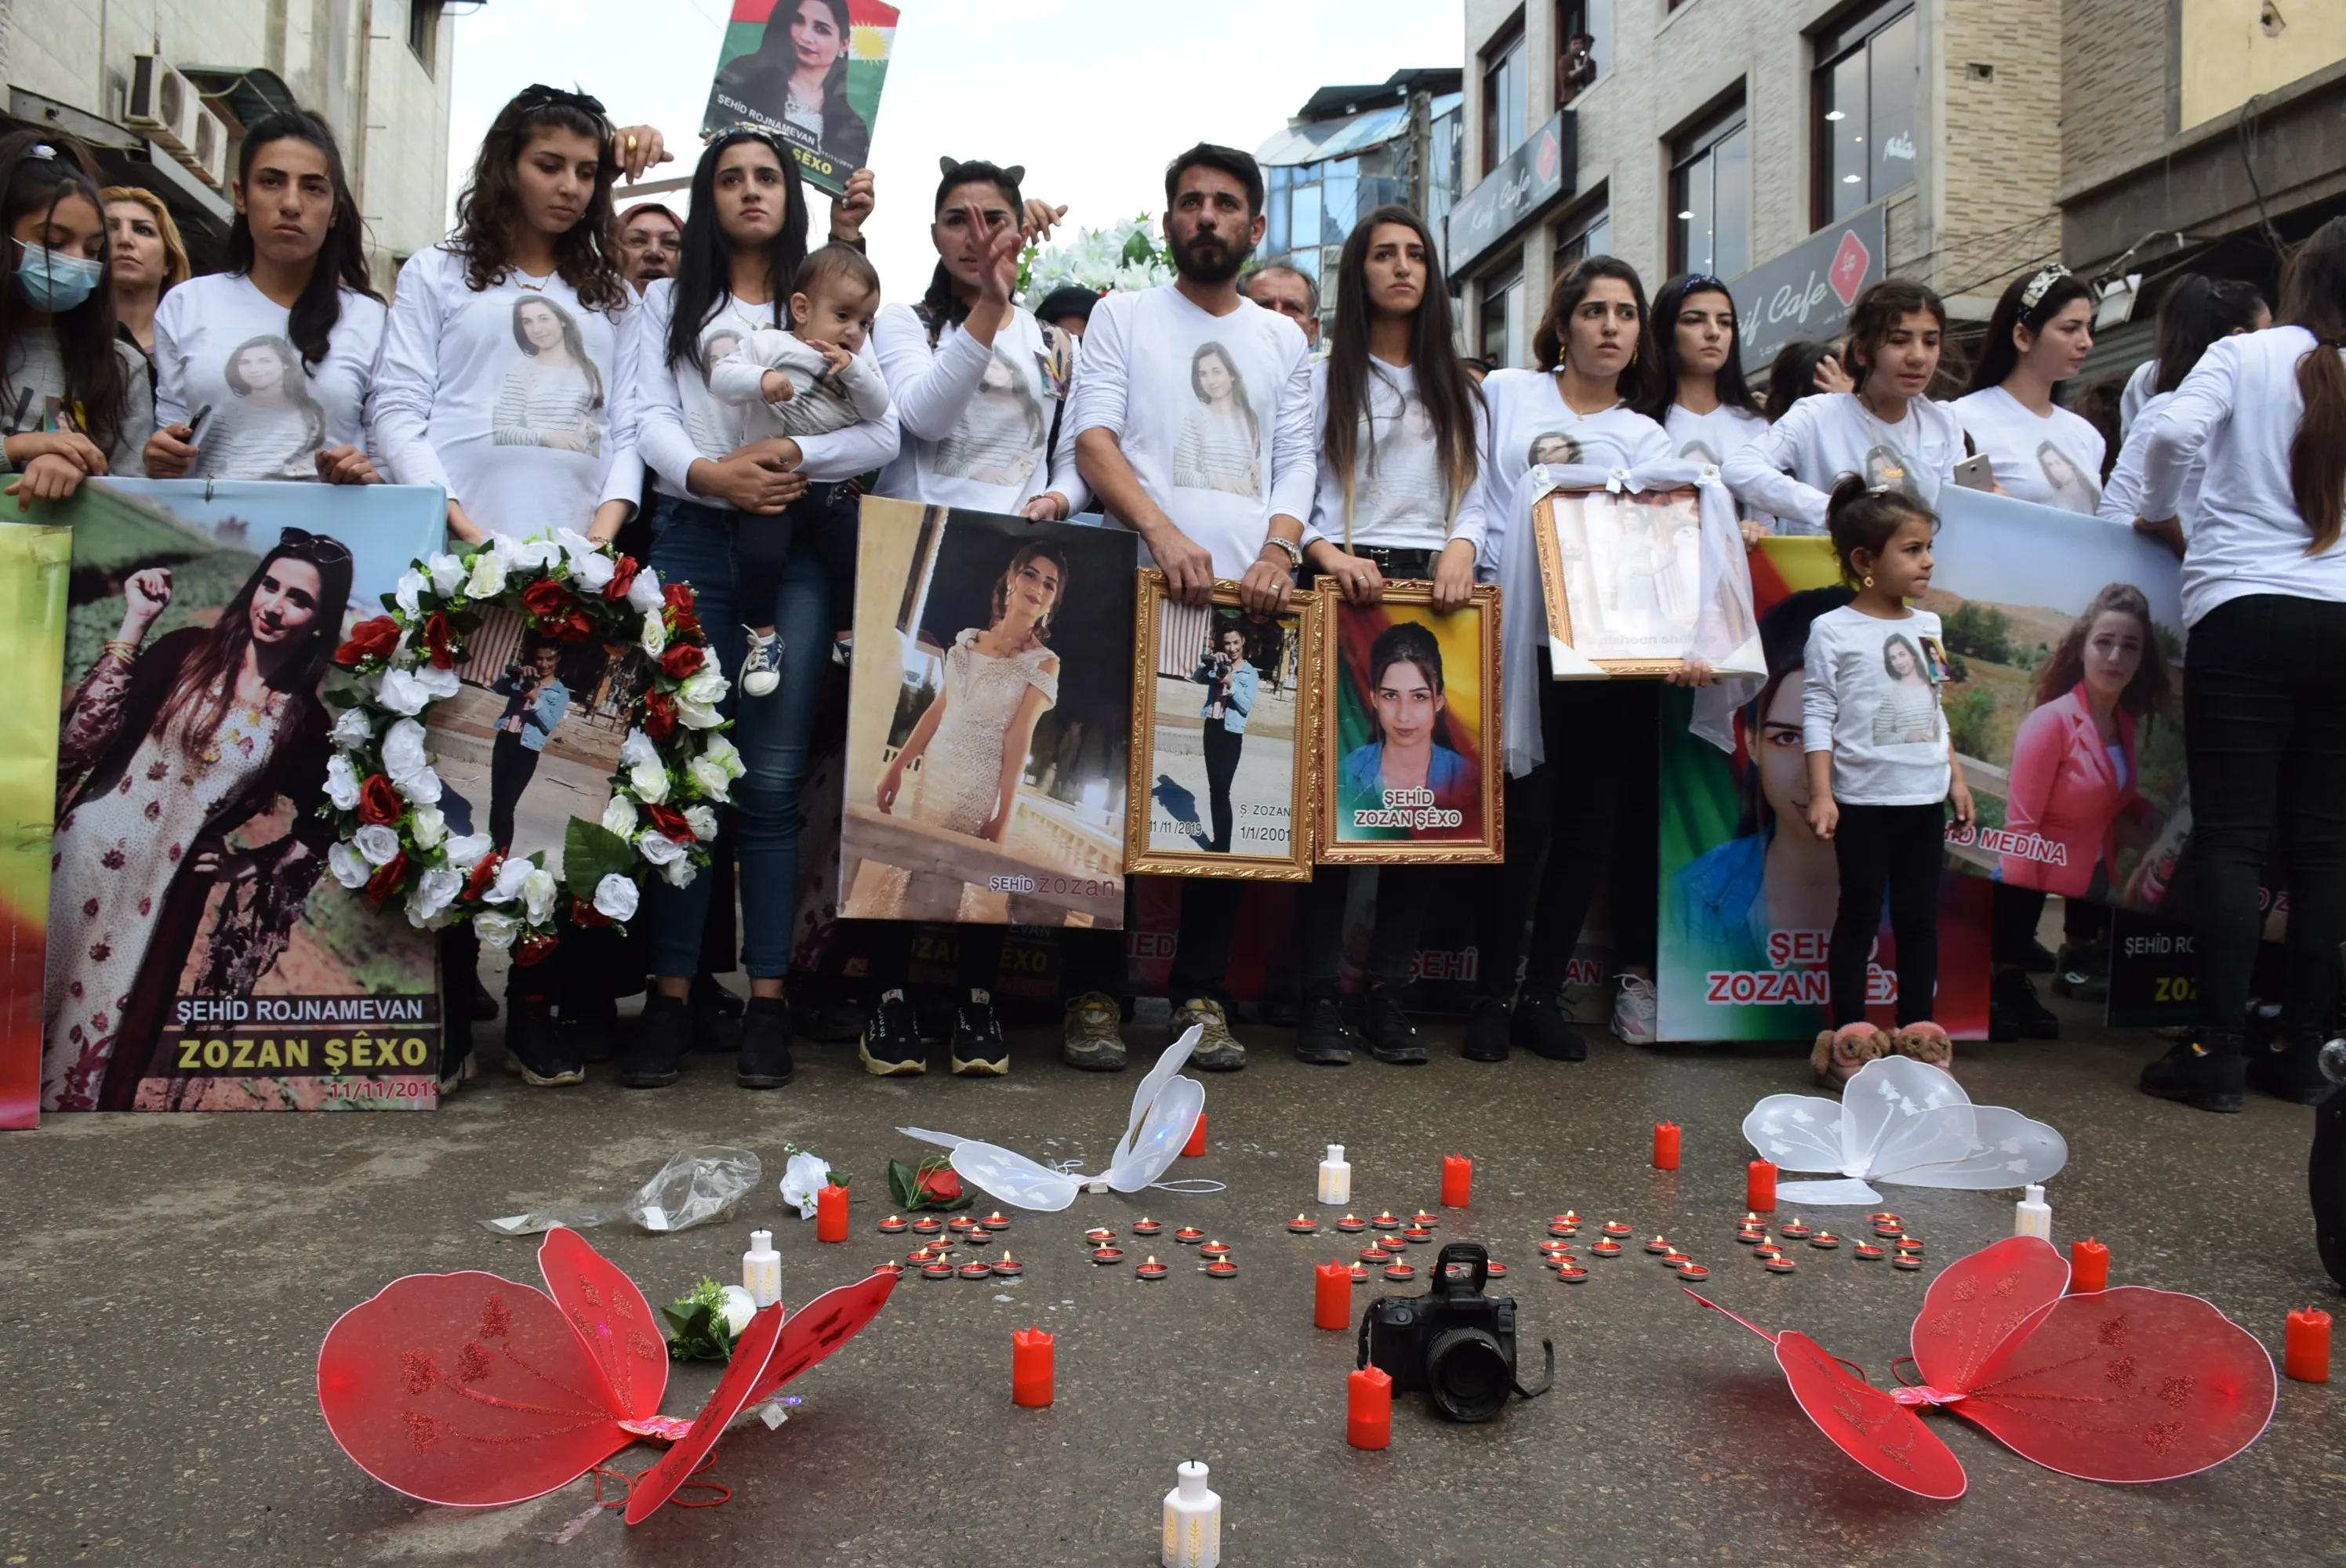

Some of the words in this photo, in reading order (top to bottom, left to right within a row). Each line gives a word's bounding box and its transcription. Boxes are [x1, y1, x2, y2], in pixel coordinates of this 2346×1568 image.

[1767, 270, 1828, 324] Cafe
[1382, 786, 1434, 809] ŞEHÎD
[1253, 805, 1291, 817] ZOZAN
[1354, 810, 1413, 826] ZOZAN
[1414, 806, 1463, 829] ŞÊXO
[990, 874, 1035, 893] ŞEHÎD
[1038, 877, 1115, 897] zozan
[1705, 970, 1829, 1005] ZOZAN
[176, 995, 249, 1025] ŞEHÎD
[256, 1000, 423, 1021] ROJNAMEVAN
[178, 1040, 309, 1069] ZOZAN
[324, 1030, 428, 1076] ŞÊXO
